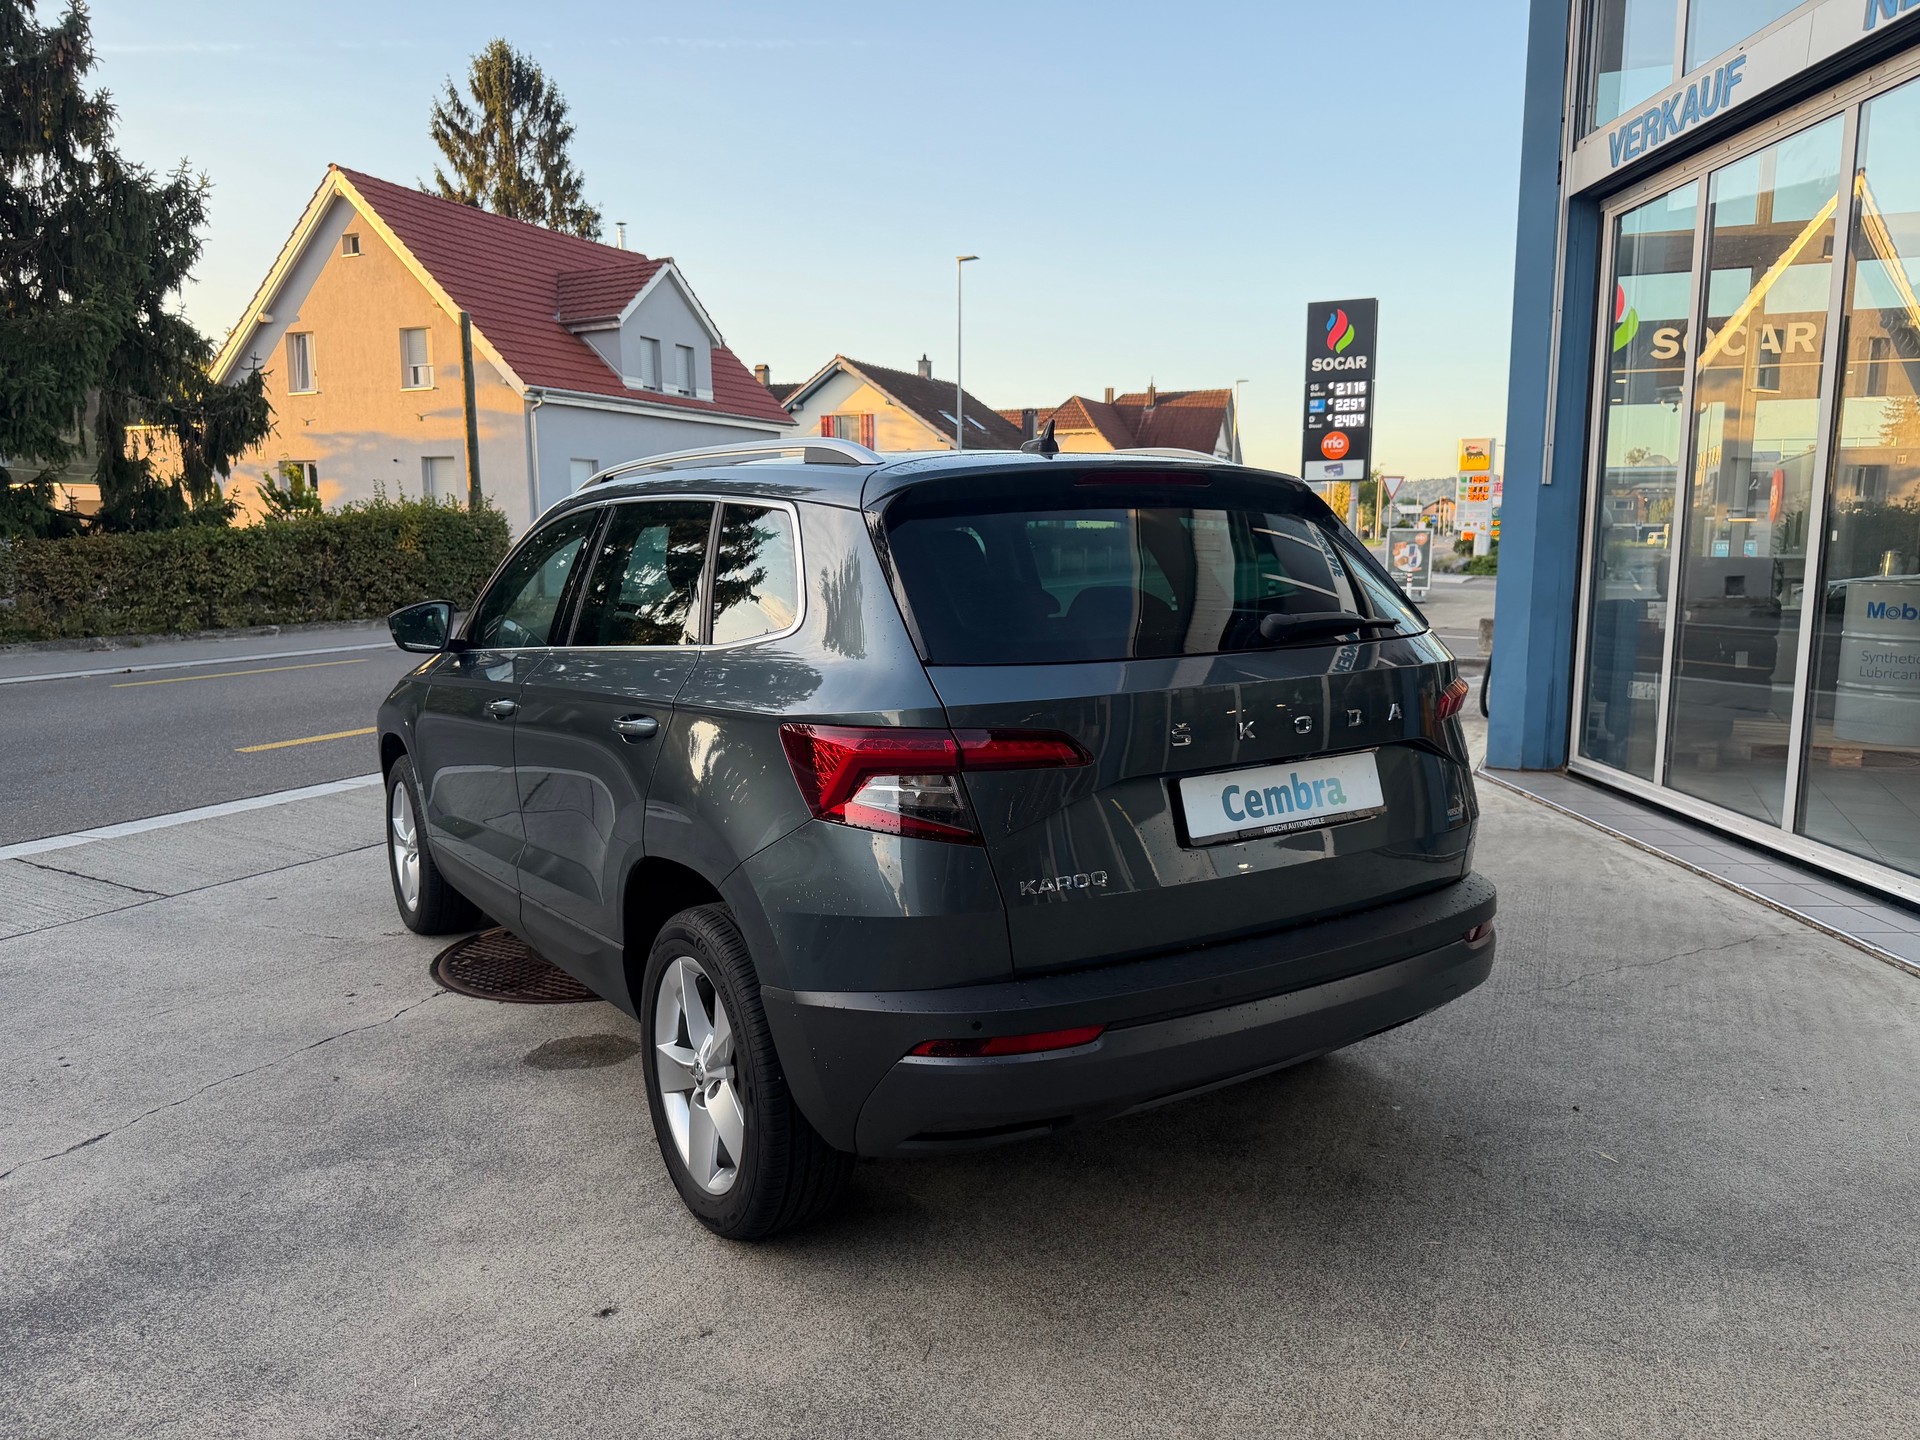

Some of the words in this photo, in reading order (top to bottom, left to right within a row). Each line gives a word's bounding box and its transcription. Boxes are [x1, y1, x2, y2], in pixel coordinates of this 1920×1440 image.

[1608, 54, 1747, 168] VERKAUF
[1311, 355, 1367, 372] SOCAR
[1866, 601, 1920, 620] Mob
[1221, 773, 1347, 822] Cembra
[1288, 817, 1326, 830] AUTOMOBILE
[1020, 870, 1108, 896] KAROQ
